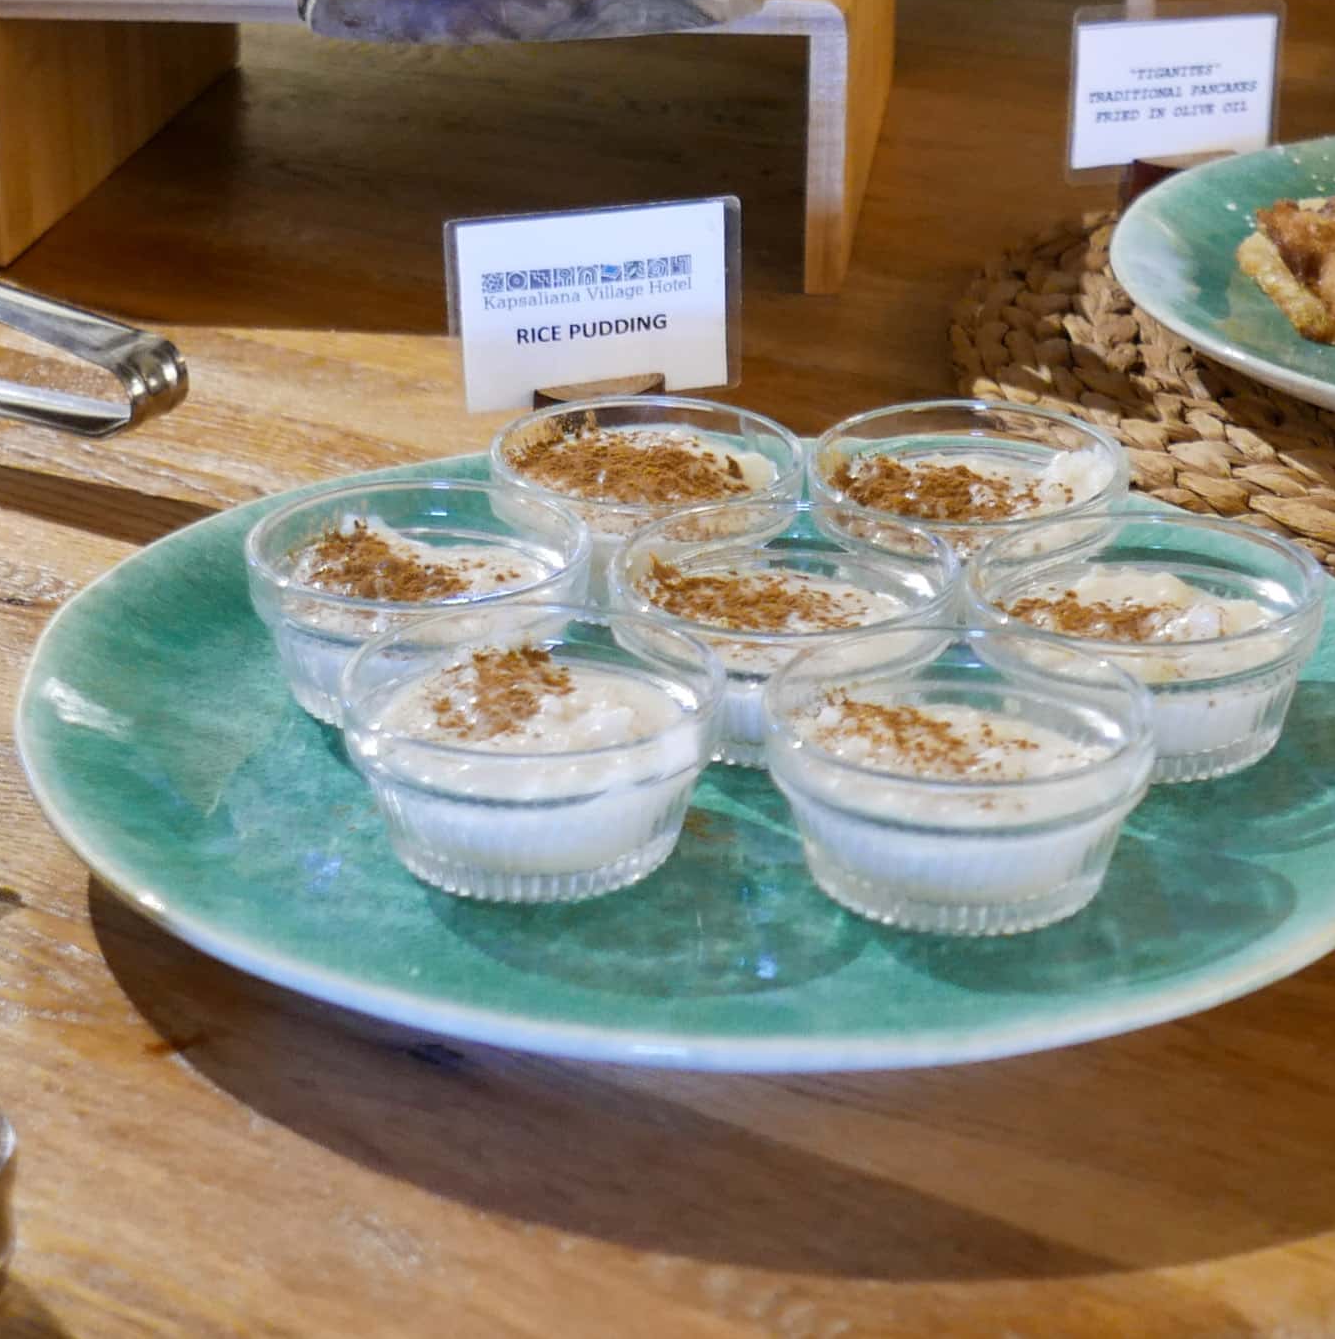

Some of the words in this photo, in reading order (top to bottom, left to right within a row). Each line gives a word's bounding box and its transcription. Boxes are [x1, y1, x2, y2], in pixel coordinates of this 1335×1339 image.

[1089, 86, 1183, 104] TRADITIONAL
[1190, 80, 1257, 97] PANCAKES
[1095, 109, 1140, 124] FRIED
[1148, 106, 1167, 120] IN
[1173, 104, 1214, 118] OLIVE
[1222, 99, 1249, 114] OIL
[483, 291, 581, 311] Kapsaliana
[587, 283, 644, 302] Village
[649, 277, 693, 294] Hotel
[516, 325, 561, 345] RICE
[569, 313, 668, 341] PUDDING
